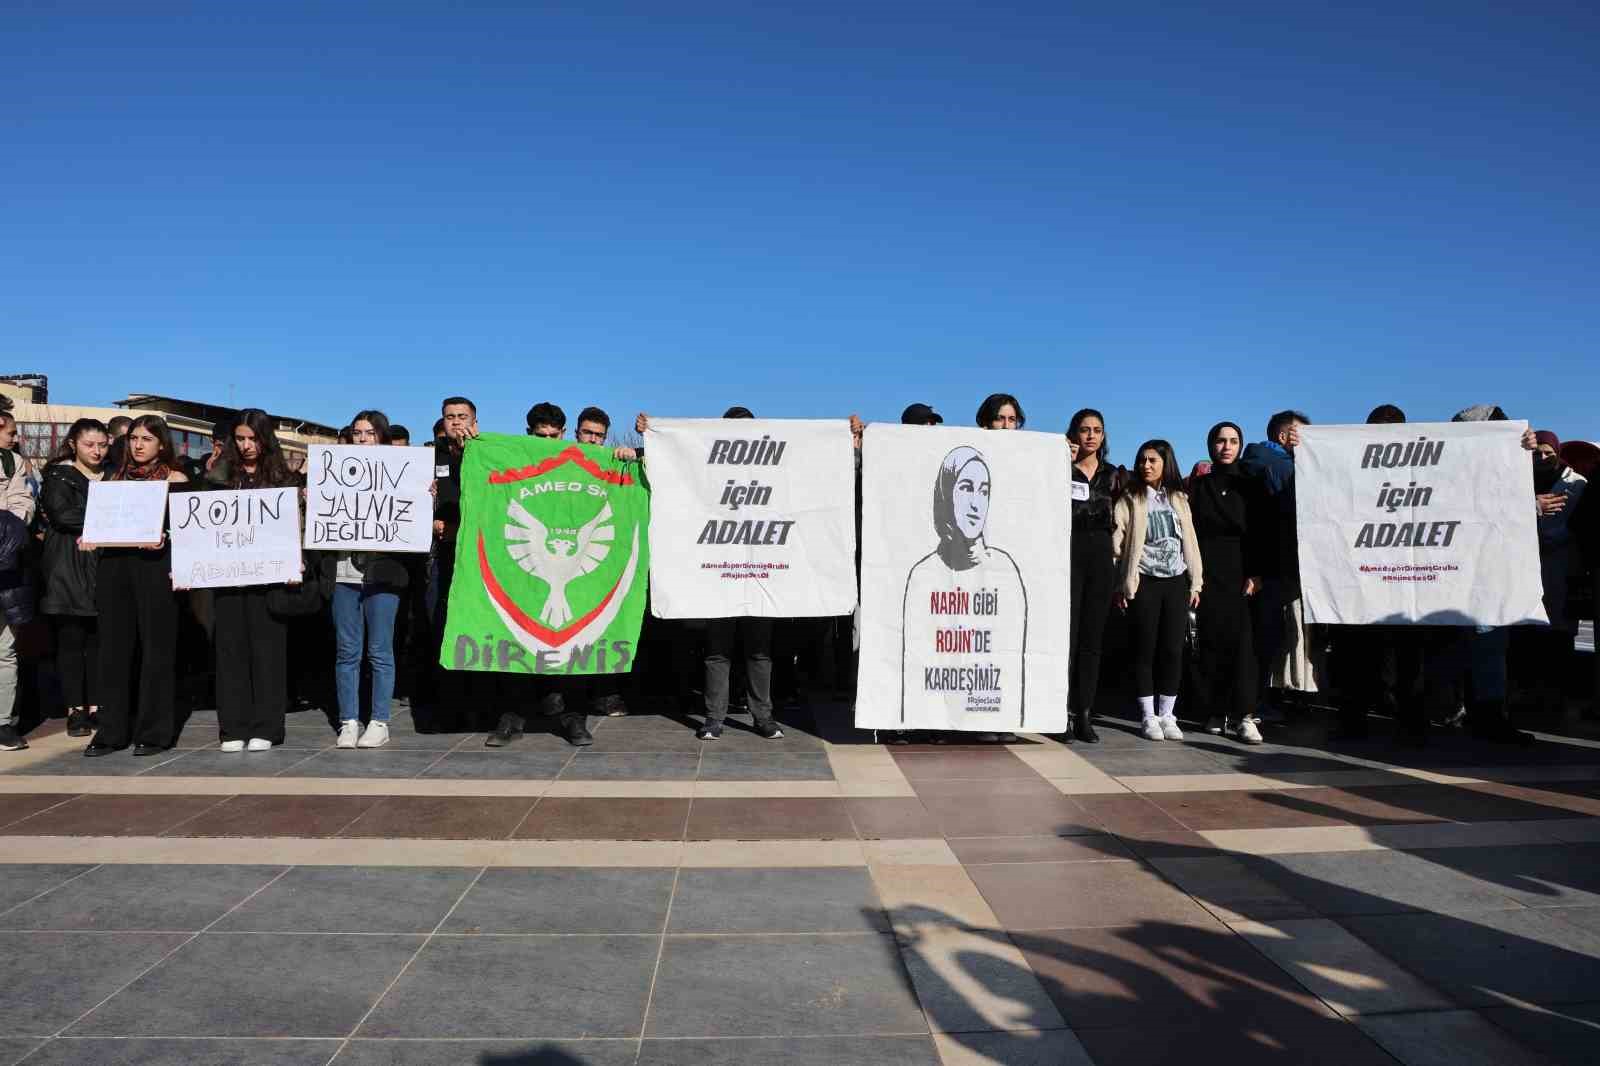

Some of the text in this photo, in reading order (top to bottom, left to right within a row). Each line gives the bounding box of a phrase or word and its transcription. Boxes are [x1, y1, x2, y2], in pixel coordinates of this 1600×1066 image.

[708, 434, 787, 466] ROJİN
[1361, 437, 1446, 469] ROJİN
[520, 481, 582, 500] AMED
[720, 479, 774, 512] için
[1376, 482, 1433, 513] için
[697, 519, 796, 545] ADALET
[1354, 520, 1462, 549] ADALET
[930, 586, 998, 616] NARİN GİBİ
[924, 664, 1001, 695] KARDEŞİMİZ
